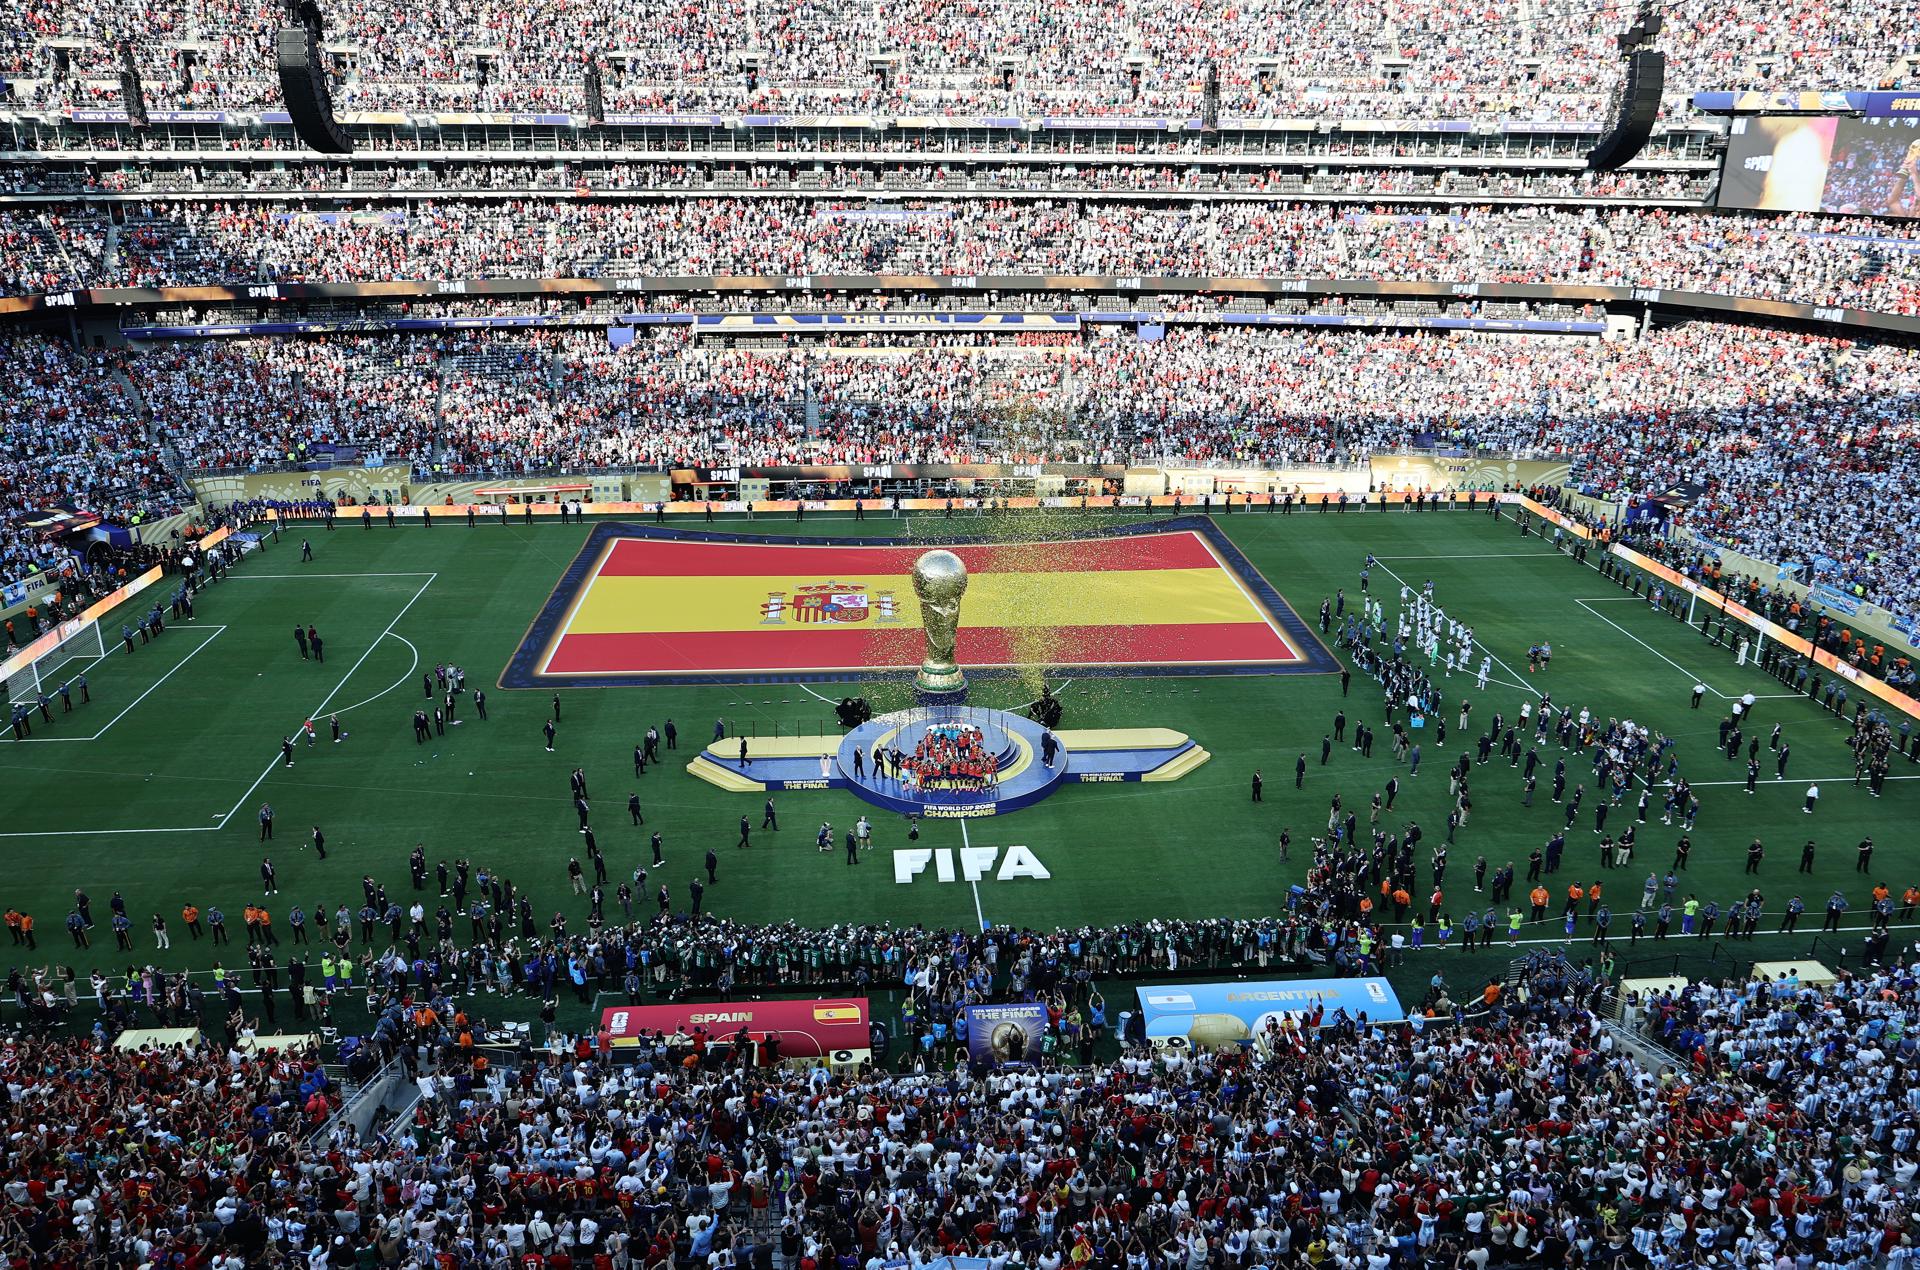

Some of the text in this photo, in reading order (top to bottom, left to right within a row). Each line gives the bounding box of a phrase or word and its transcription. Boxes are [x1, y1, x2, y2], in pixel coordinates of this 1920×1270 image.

[842, 315, 942, 324] THE FINAL
[301, 479, 321, 487] FIFA
[26, 579, 45, 592] FIFA
[974, 803, 996, 811] 2026
[924, 809, 996, 818] CHAMPIONS
[893, 846, 1051, 884] FIFA
[1228, 989, 1341, 1002] ARGENTINA
[689, 1012, 753, 1024] SPAIN
[973, 1010, 1041, 1020] THE FINAL
[584, 1186, 592, 1195] 10
